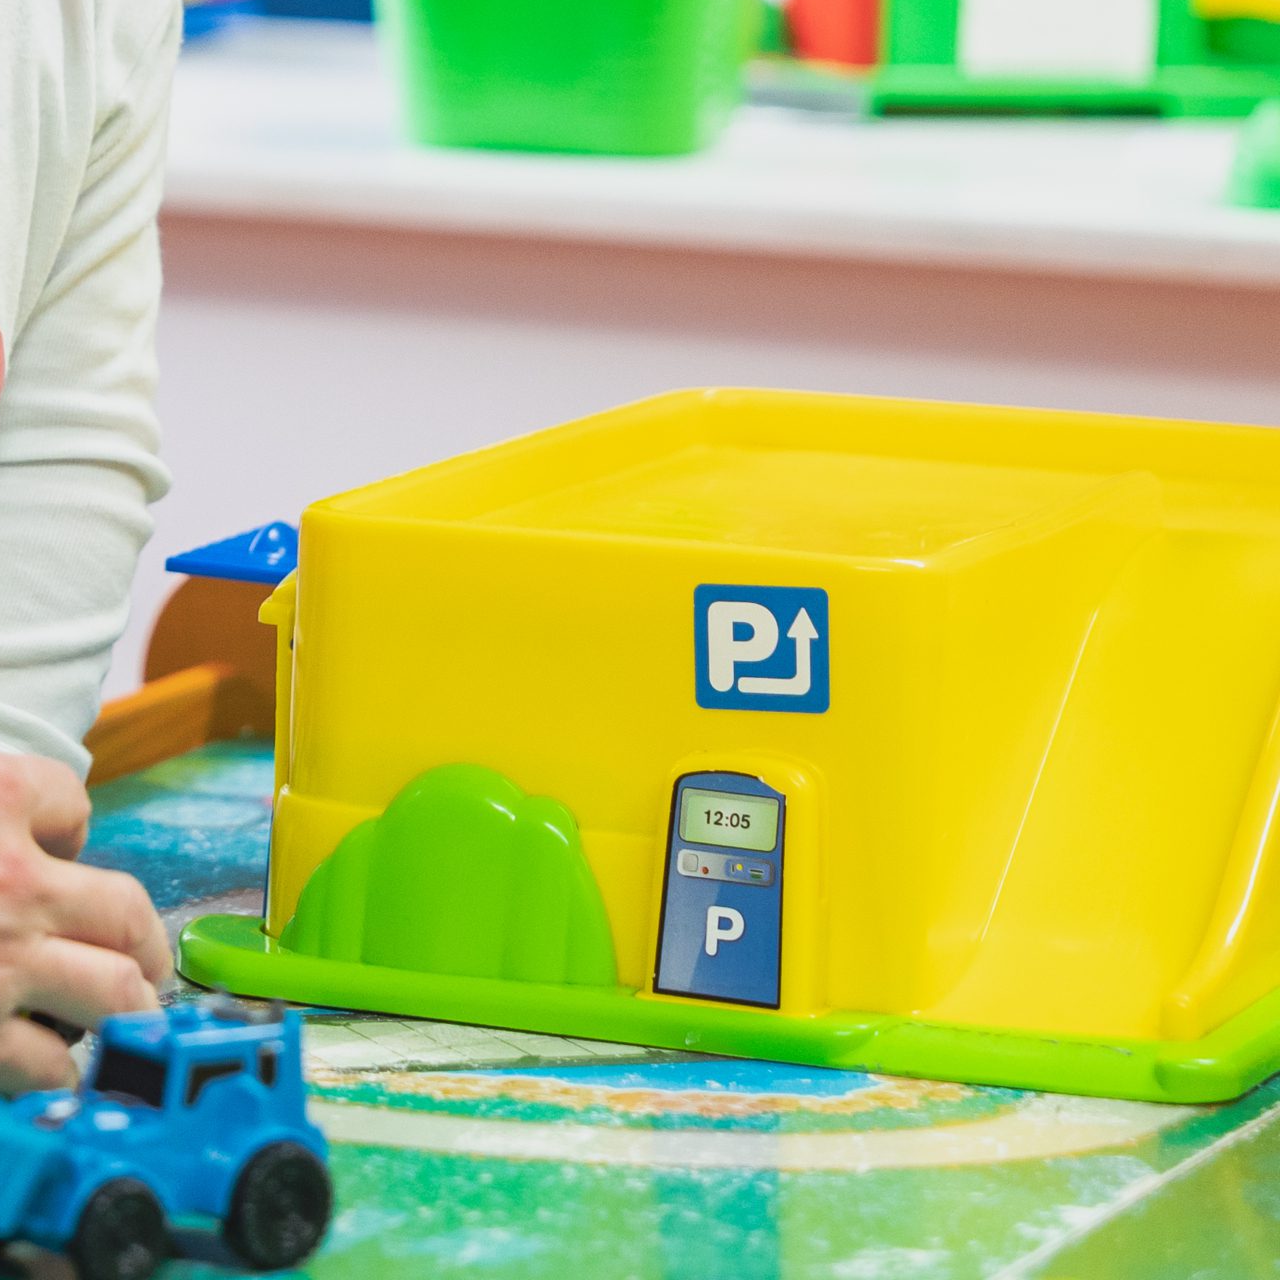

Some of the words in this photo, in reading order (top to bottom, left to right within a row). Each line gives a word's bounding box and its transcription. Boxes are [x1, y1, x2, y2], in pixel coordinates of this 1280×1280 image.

[707, 601, 779, 692] P
[703, 809, 751, 830] 12:05
[705, 906, 745, 956] P
